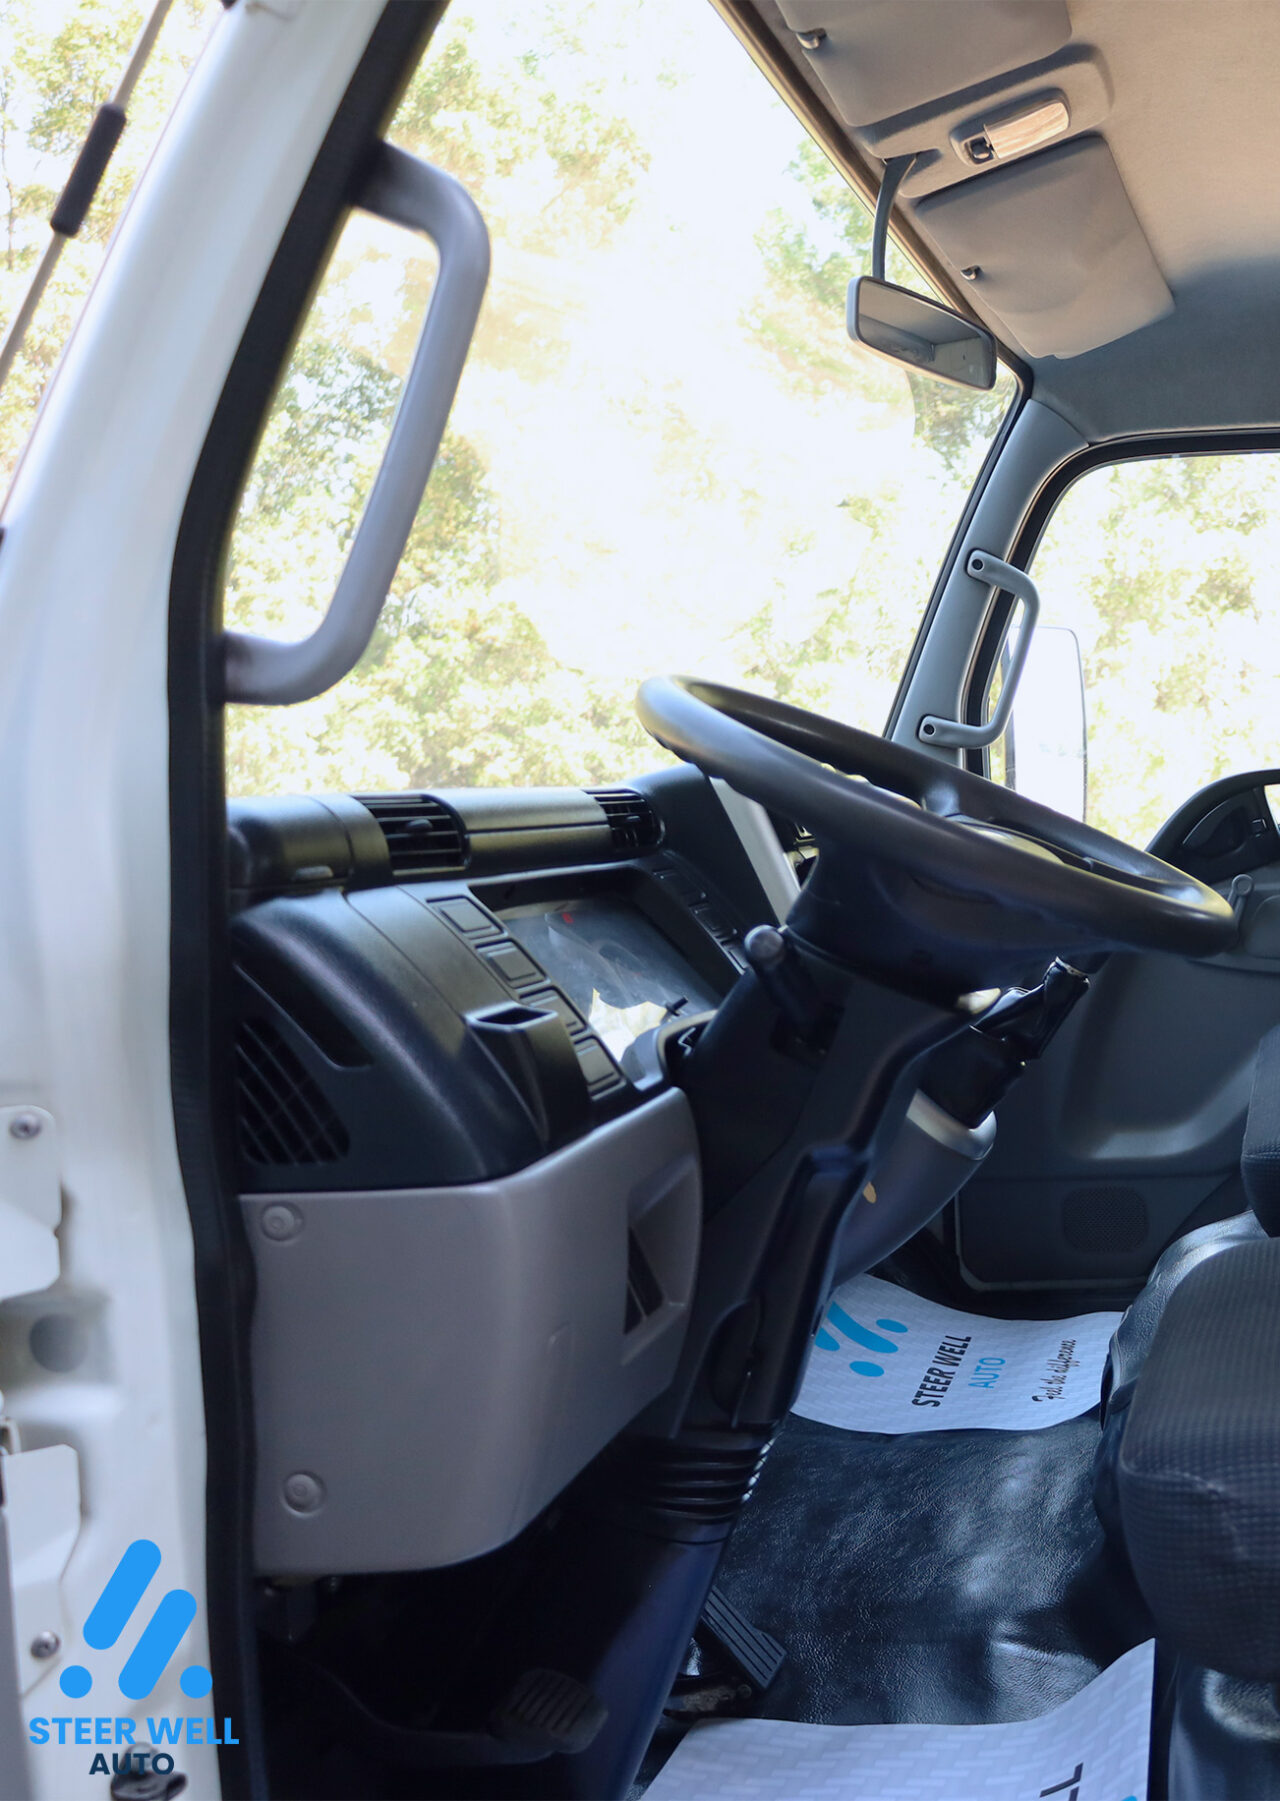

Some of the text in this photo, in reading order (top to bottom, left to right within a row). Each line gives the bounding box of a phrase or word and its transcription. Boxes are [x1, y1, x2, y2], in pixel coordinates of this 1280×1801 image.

[911, 1335, 972, 1407] STEER WELL
[968, 1357, 1006, 1389] AUTO
